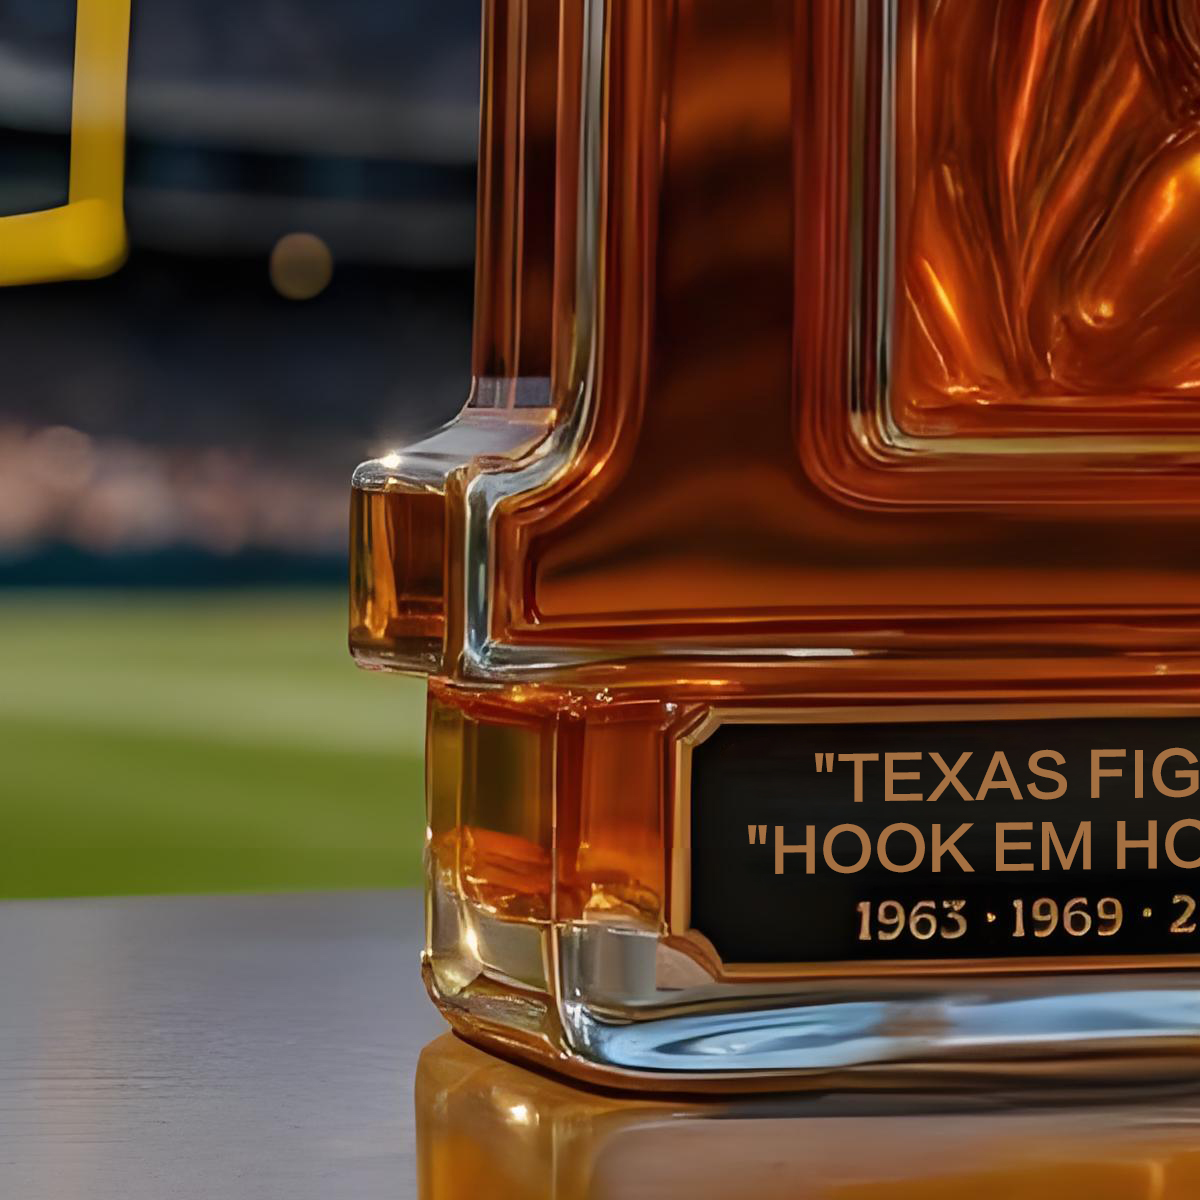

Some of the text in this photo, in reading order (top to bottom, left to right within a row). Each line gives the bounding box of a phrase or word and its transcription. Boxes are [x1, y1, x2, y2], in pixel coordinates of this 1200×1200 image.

[814, 749, 1068, 803] "TEXAS
[747, 821, 976, 875] "HOOK
[995, 820, 1092, 873] EM
[856, 898, 968, 941] 1963
[1012, 896, 1124, 938] 1969
